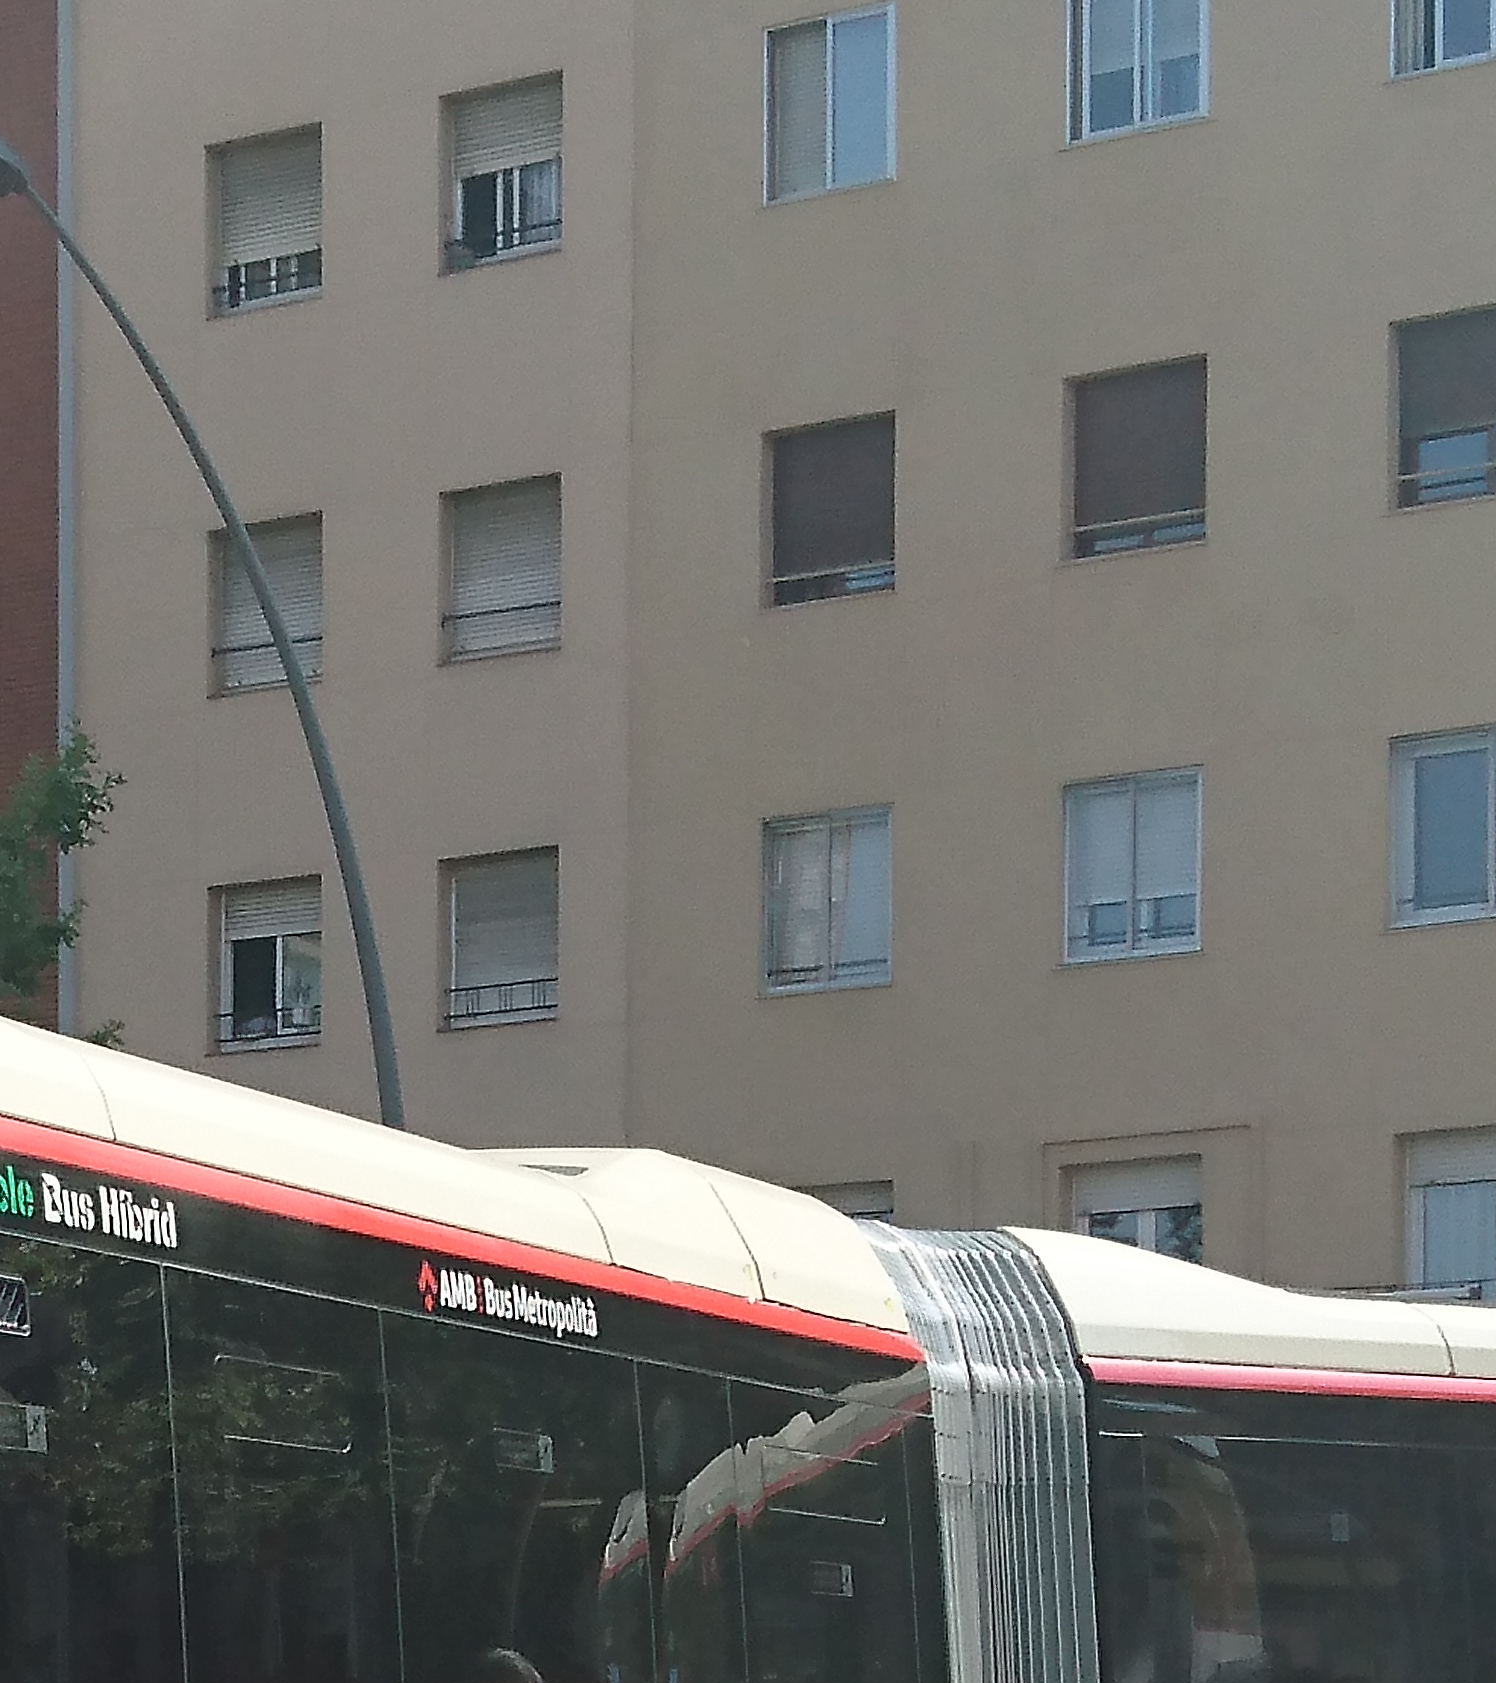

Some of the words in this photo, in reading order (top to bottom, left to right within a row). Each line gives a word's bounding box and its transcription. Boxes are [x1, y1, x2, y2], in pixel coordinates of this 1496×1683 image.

[41, 1172, 96, 1231] Bus
[440, 1269, 478, 1312] AMB
[483, 1277, 513, 1319] Bus
[512, 1283, 598, 1338] Metropolità
